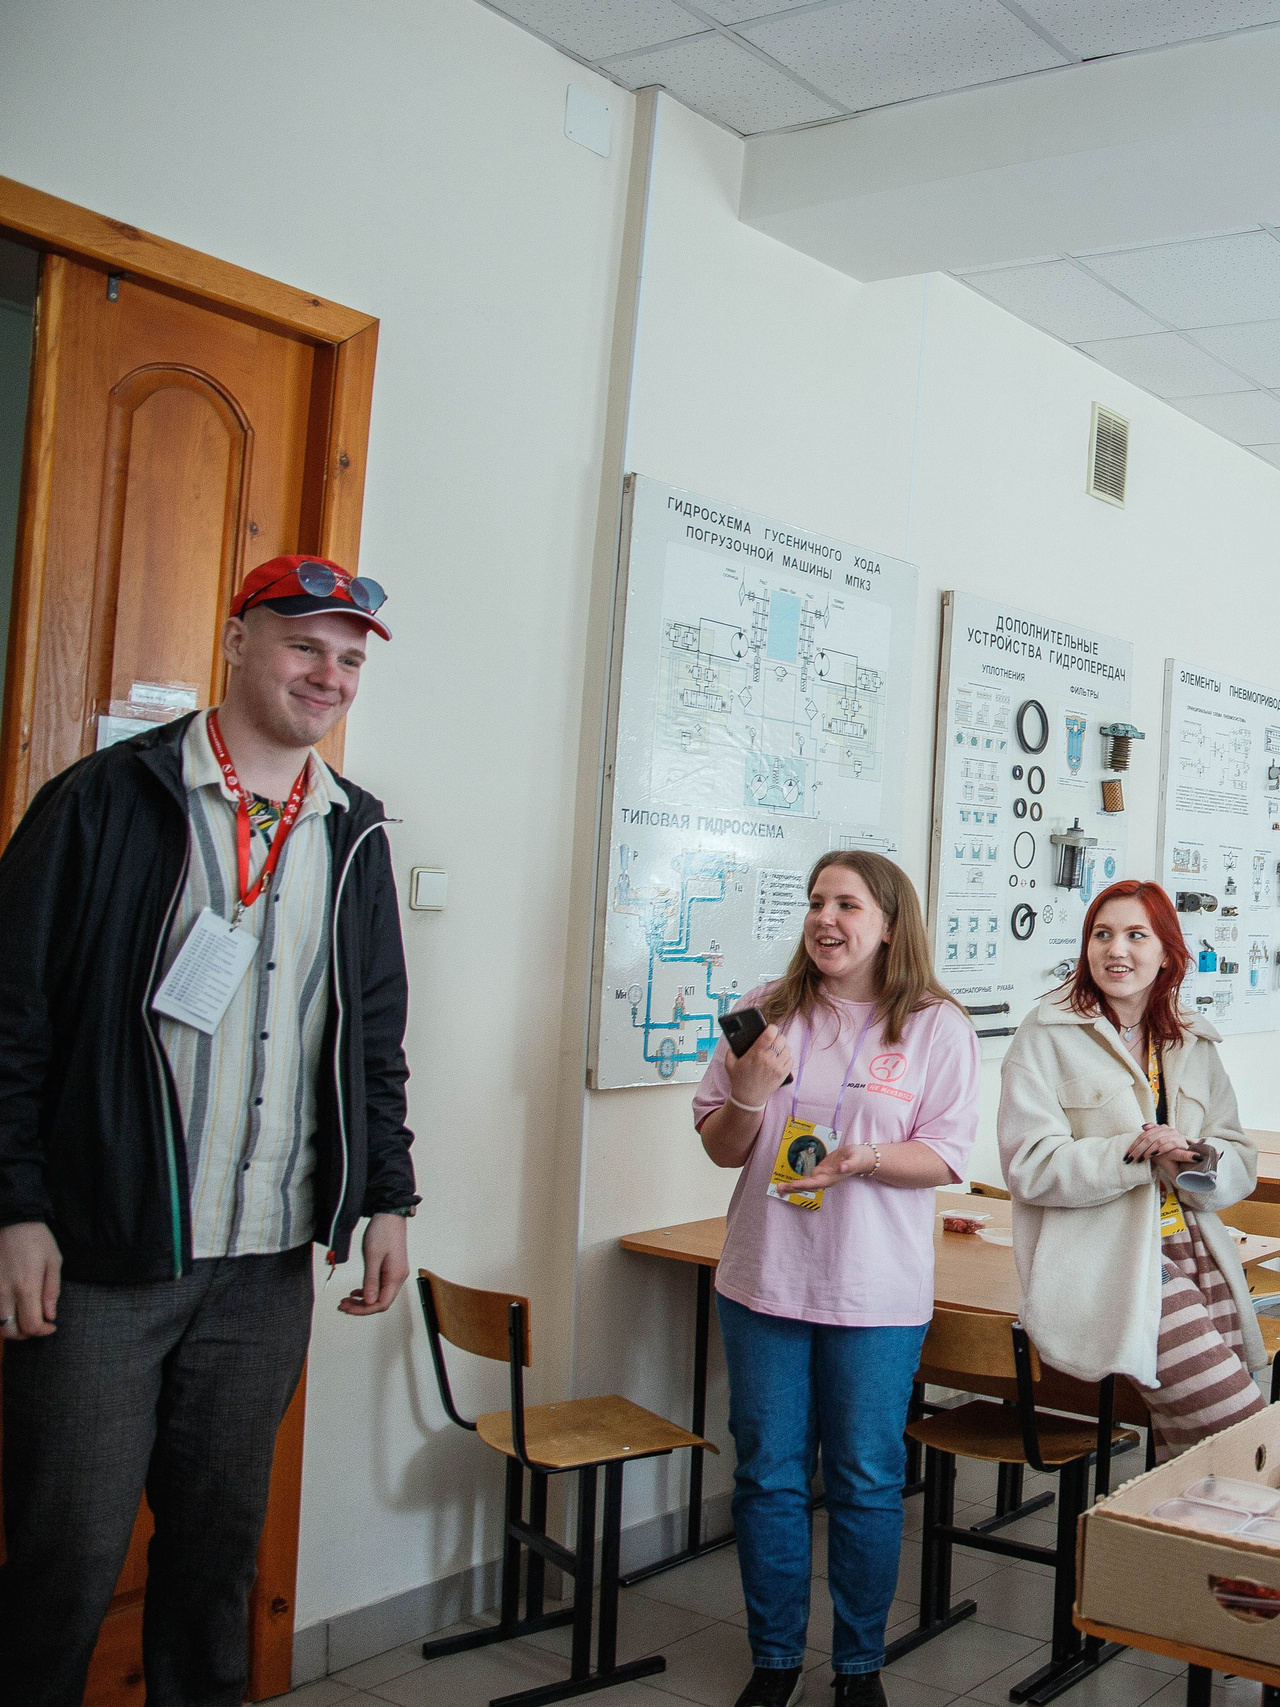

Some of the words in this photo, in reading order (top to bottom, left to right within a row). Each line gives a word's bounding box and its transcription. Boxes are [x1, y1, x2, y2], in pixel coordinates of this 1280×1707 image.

[668, 496, 752, 534] ГИДРОСХЕМА
[764, 528, 842, 562] ГУСЕНИЧНОГО
[854, 556, 881, 575] ХОДА
[686, 526, 774, 563] ПОГРУЗОЧНОЙ
[782, 554, 832, 581] МАШИНЫ
[996, 614, 1098, 656] ДОПОЛНИТЕЛЬНЫЕ
[967, 627, 1042, 662] УСТРОЙСТВА
[1049, 650, 1127, 682] ГИДРОПЕРЕДАЧ
[981, 664, 1026, 682] УПЛОТНЕНИЯ
[1180, 670, 1221, 694] ЭЛЕМЕНТЫ
[1070, 685, 1100, 700] ФИЛЬТРЫ
[621, 808, 690, 830] ТИПОВАЯ
[697, 816, 784, 839] ГИДРОСХЕМА
[684, 986, 695, 996] КП
[678, 1036, 684, 1045] Н
